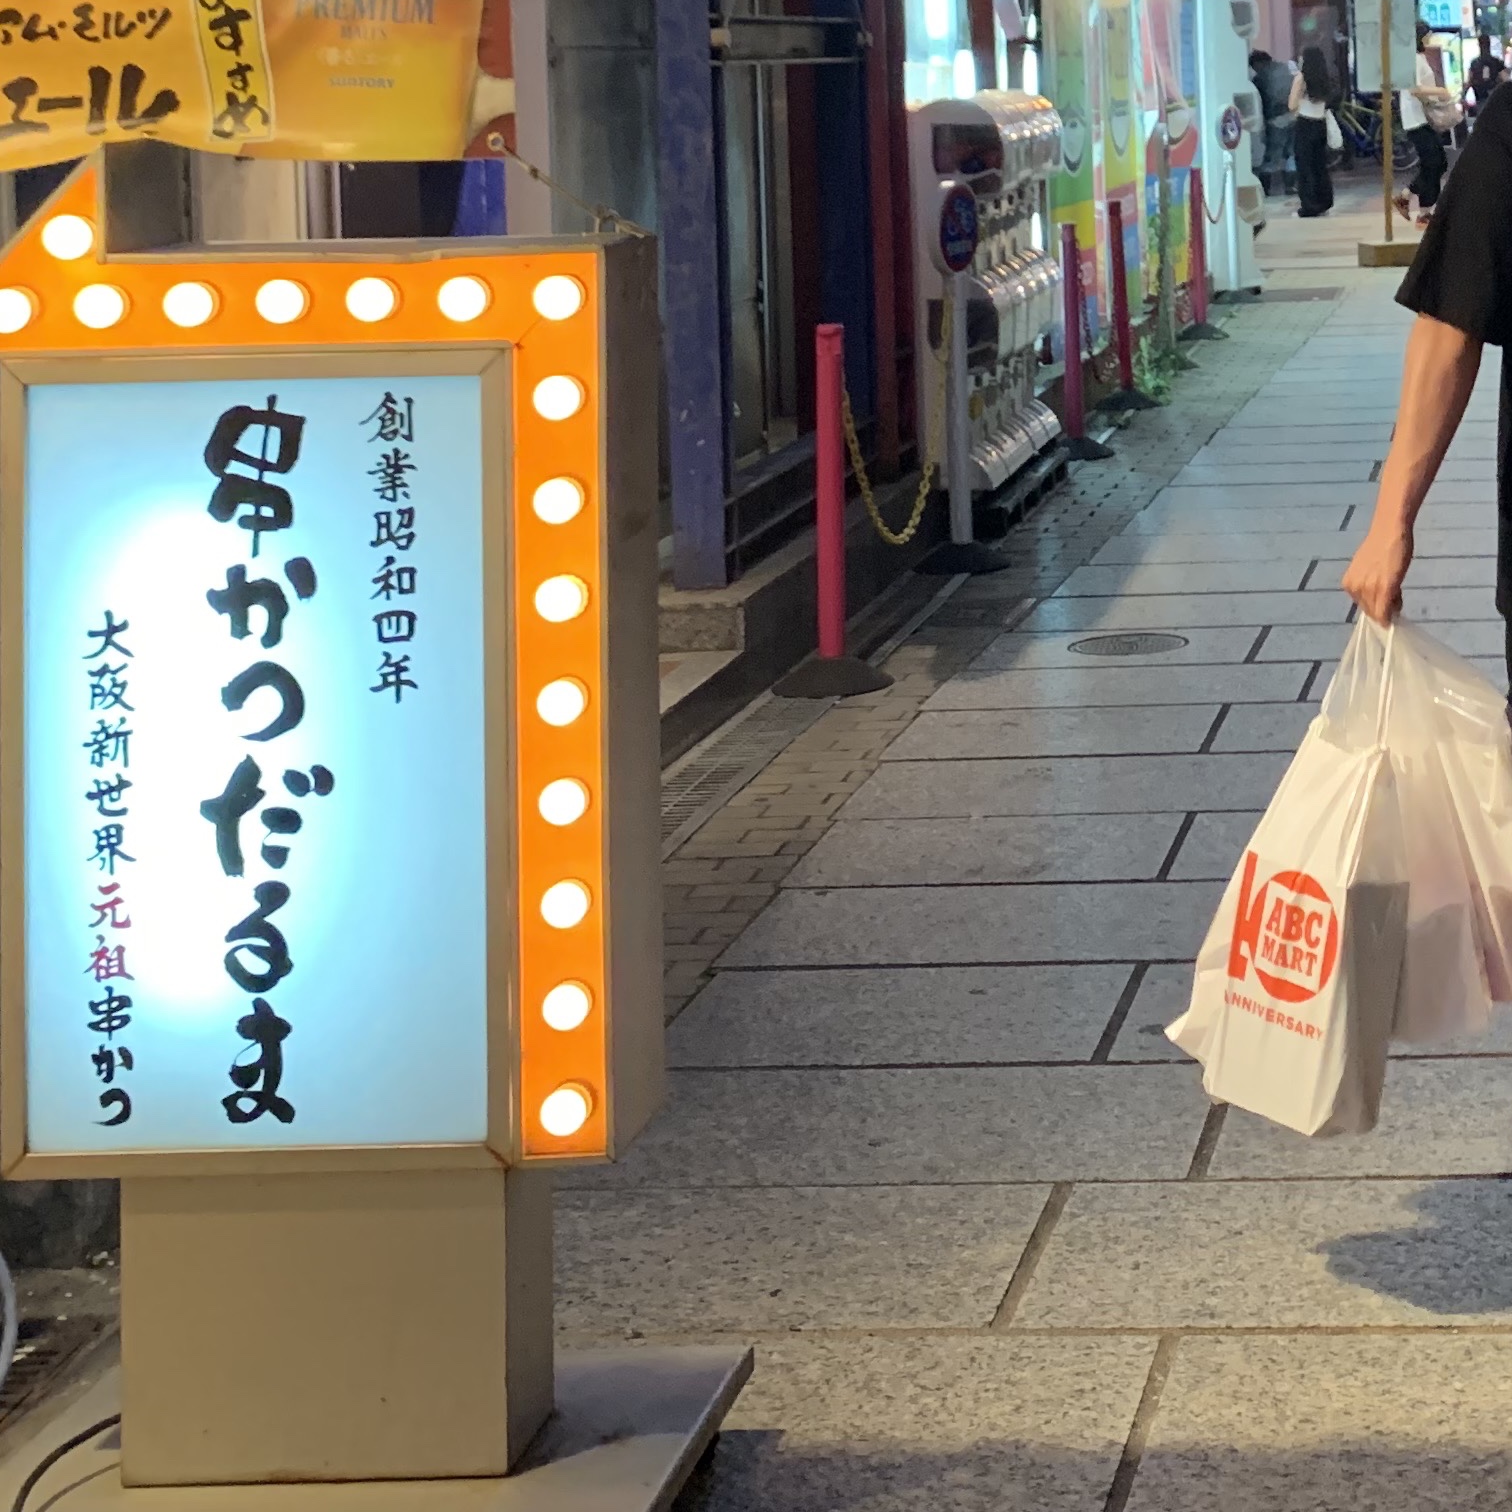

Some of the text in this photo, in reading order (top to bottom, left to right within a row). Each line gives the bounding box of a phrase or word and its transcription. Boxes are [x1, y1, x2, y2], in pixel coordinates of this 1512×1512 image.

[360, 391, 419, 704] 創業昭和四年
[200, 394, 335, 1125] 串かつだるま
[1261, 934, 1319, 978] MART
[1265, 897, 1324, 949] ABC
